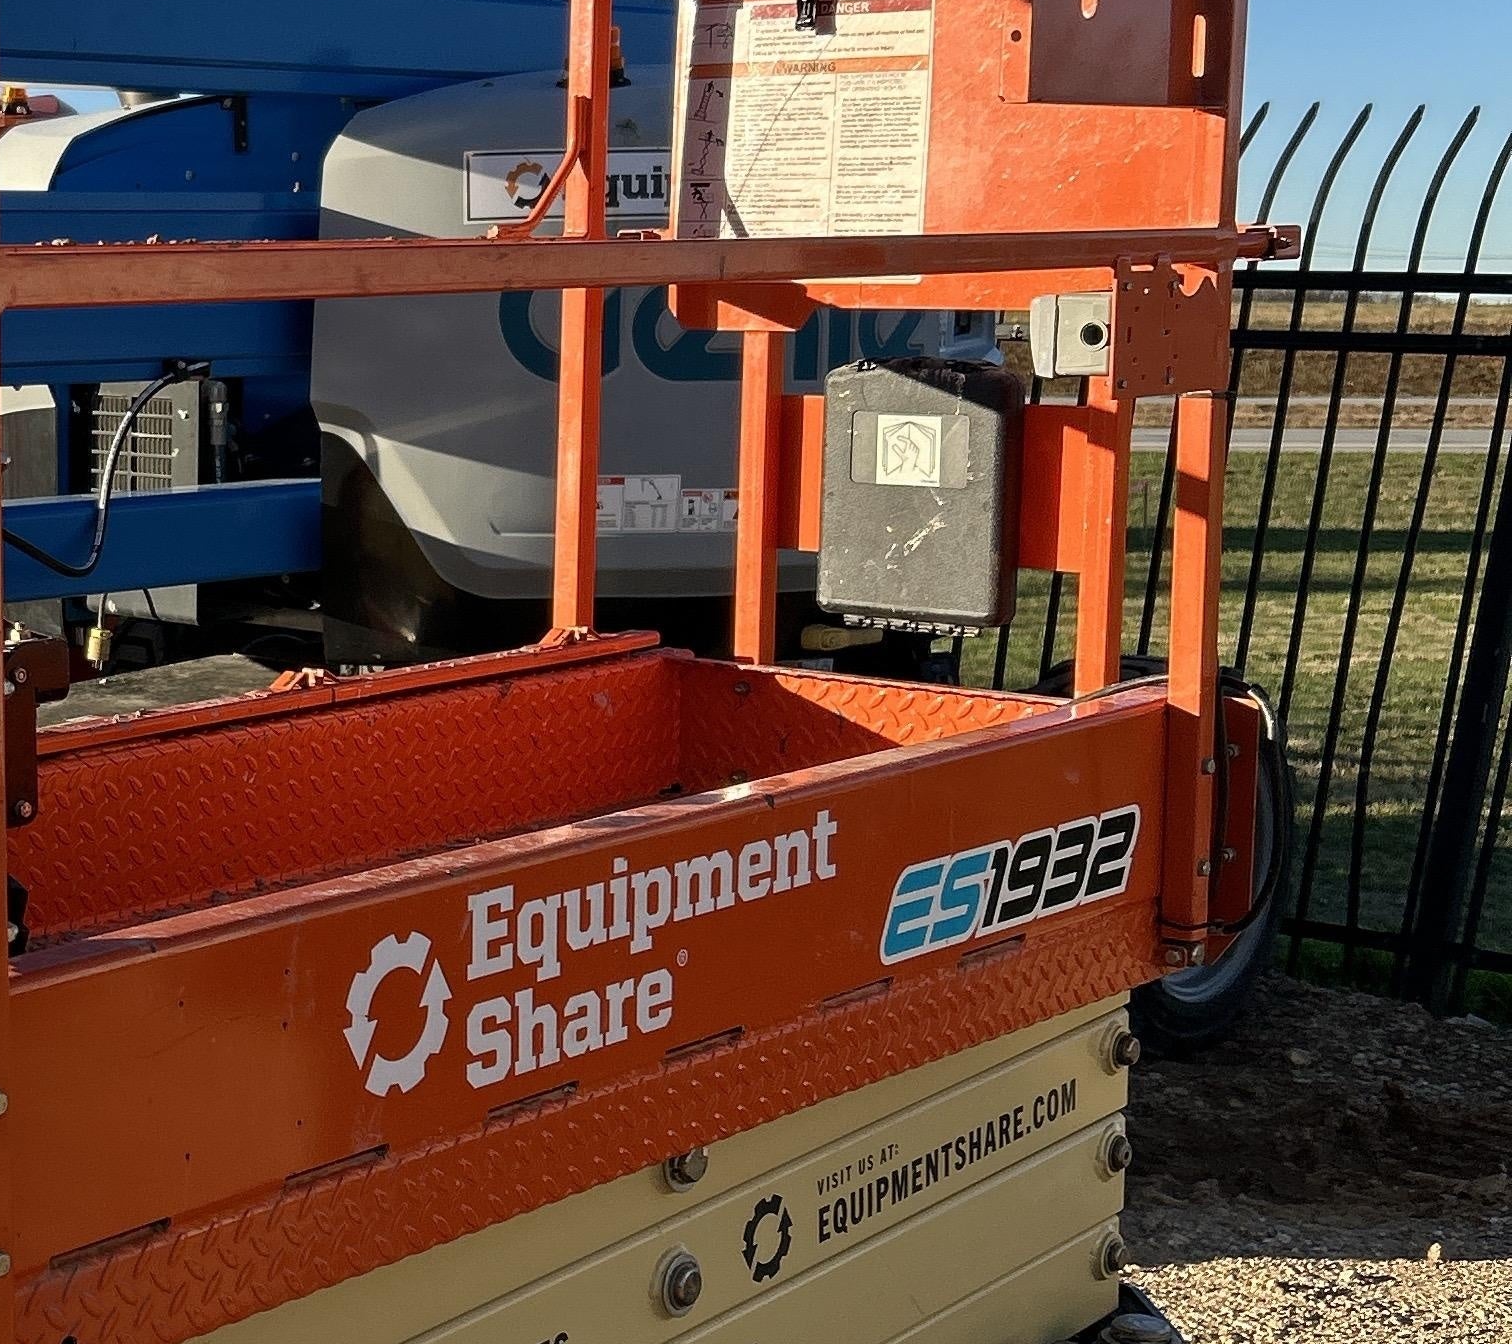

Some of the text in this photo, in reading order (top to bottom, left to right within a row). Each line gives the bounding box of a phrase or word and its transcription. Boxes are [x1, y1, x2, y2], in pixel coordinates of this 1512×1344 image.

[821, 1, 870, 15] DANGER
[466, 809, 838, 982] Equipment
[880, 804, 1140, 965] ES1932
[465, 967, 674, 1089] Share
[816, 1142, 900, 1196] VISIT US AT:
[818, 1078, 1077, 1244] EQUIPMENTSHARE.COM
